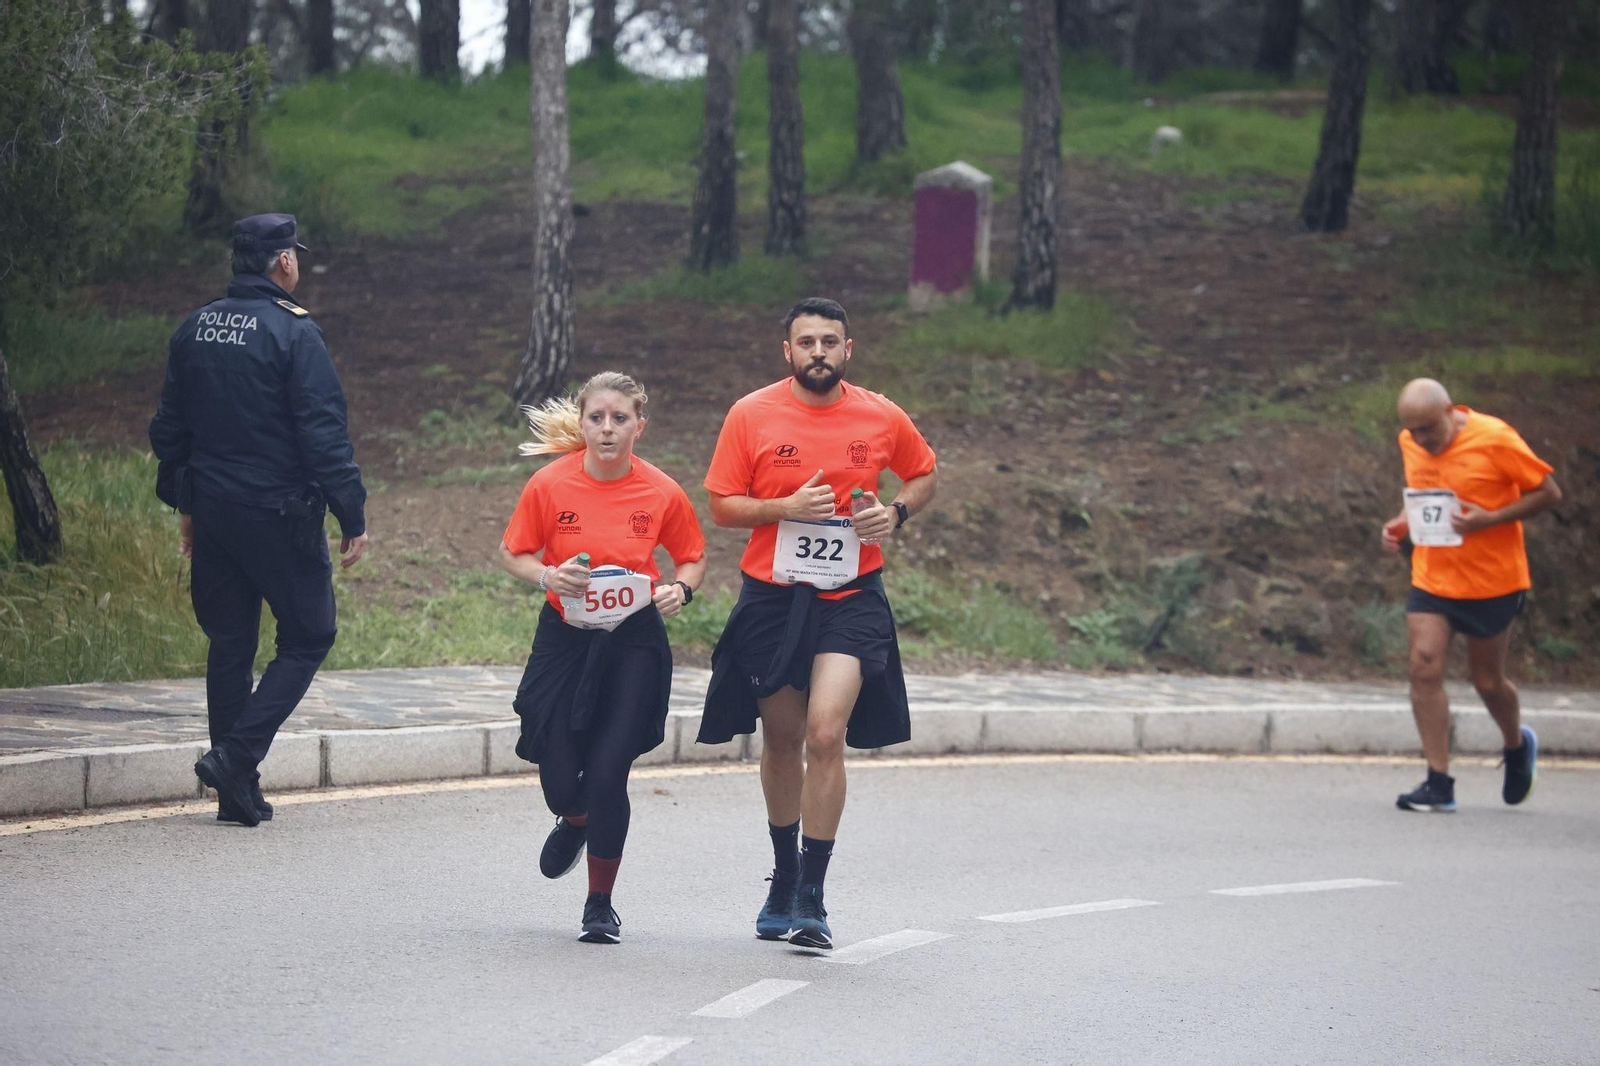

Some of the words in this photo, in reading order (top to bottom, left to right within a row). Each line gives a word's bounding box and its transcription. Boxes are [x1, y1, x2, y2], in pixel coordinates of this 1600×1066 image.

[197, 311, 257, 331] POLICIA
[195, 327, 246, 346] LOCAL
[1422, 506, 1442, 523] 67
[795, 536, 844, 562] 322
[585, 586, 634, 613] 560
